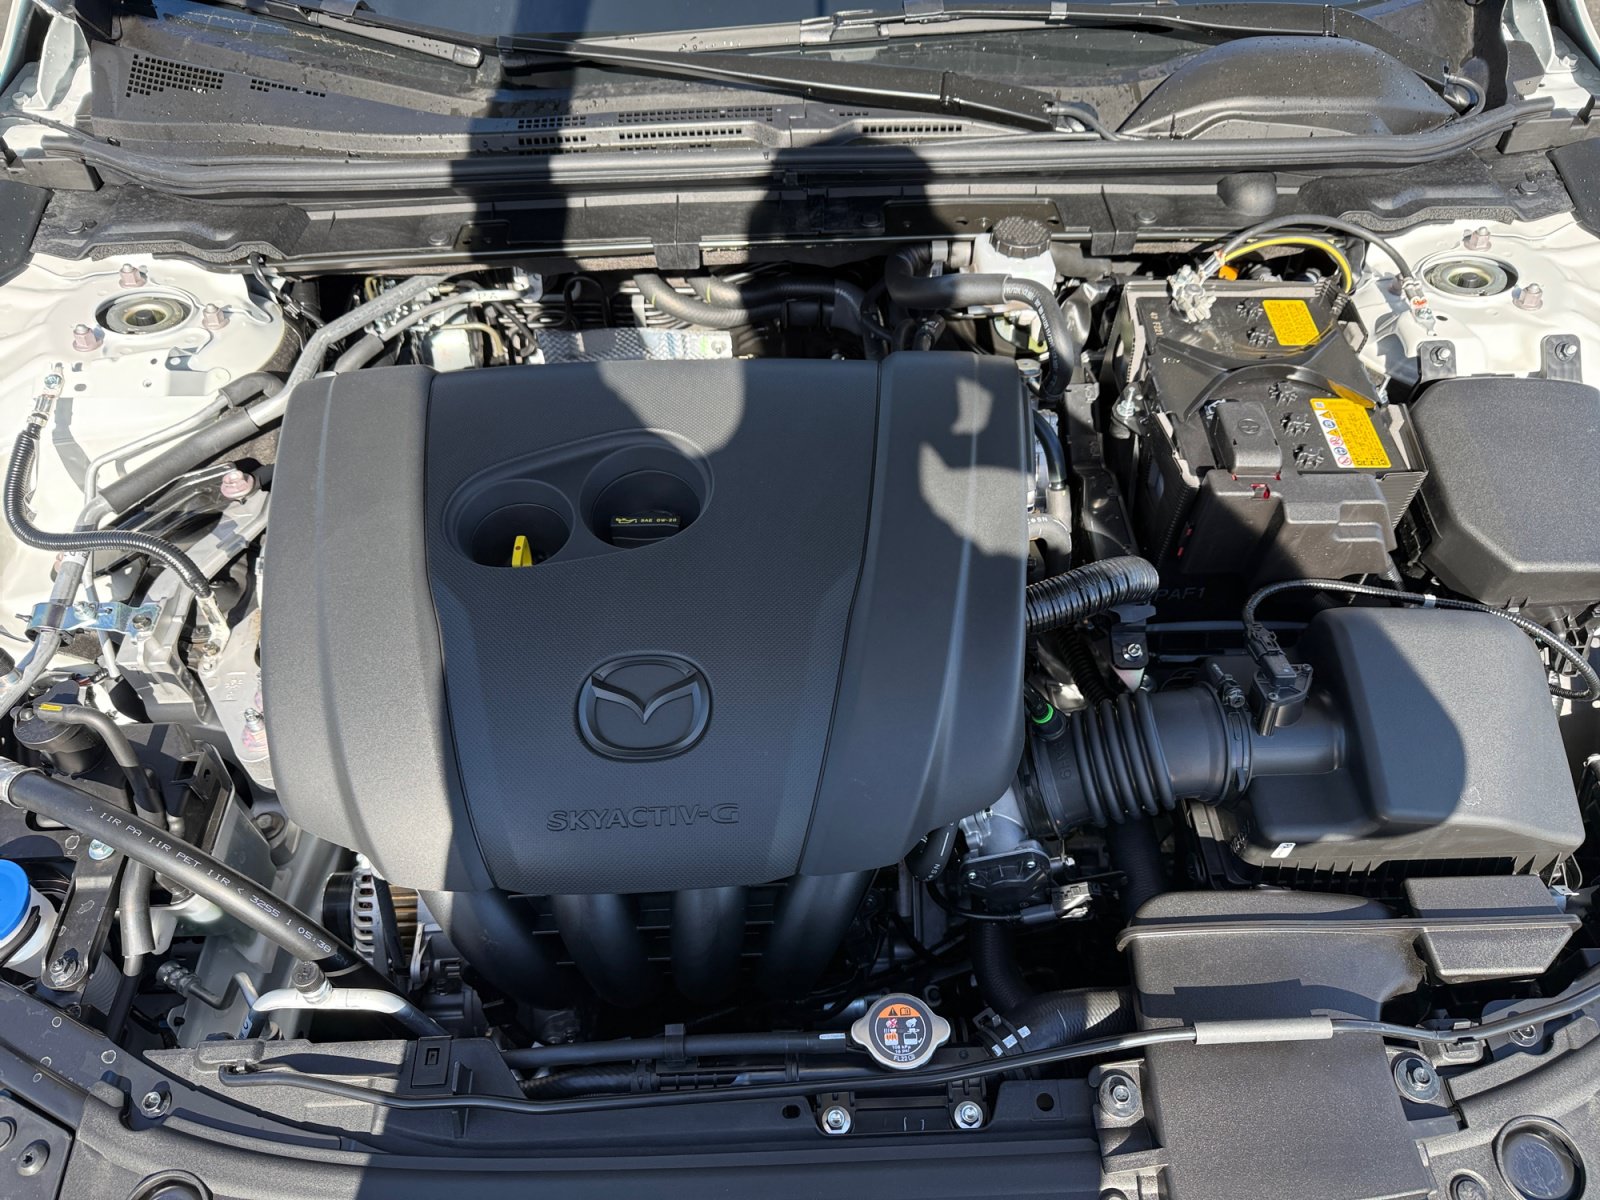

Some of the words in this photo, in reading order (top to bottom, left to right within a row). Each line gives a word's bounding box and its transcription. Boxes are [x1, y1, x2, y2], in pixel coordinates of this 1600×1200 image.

[546, 802, 740, 832] SKYACTIV-G
[99, 812, 122, 827] IIR
[125, 824, 142, 837] PA
[147, 836, 172, 852] IIR
[175, 851, 202, 868] PET
[207, 869, 231, 886] IIR
[249, 894, 281, 918] 3255
[297, 926, 332, 953] 05:38
